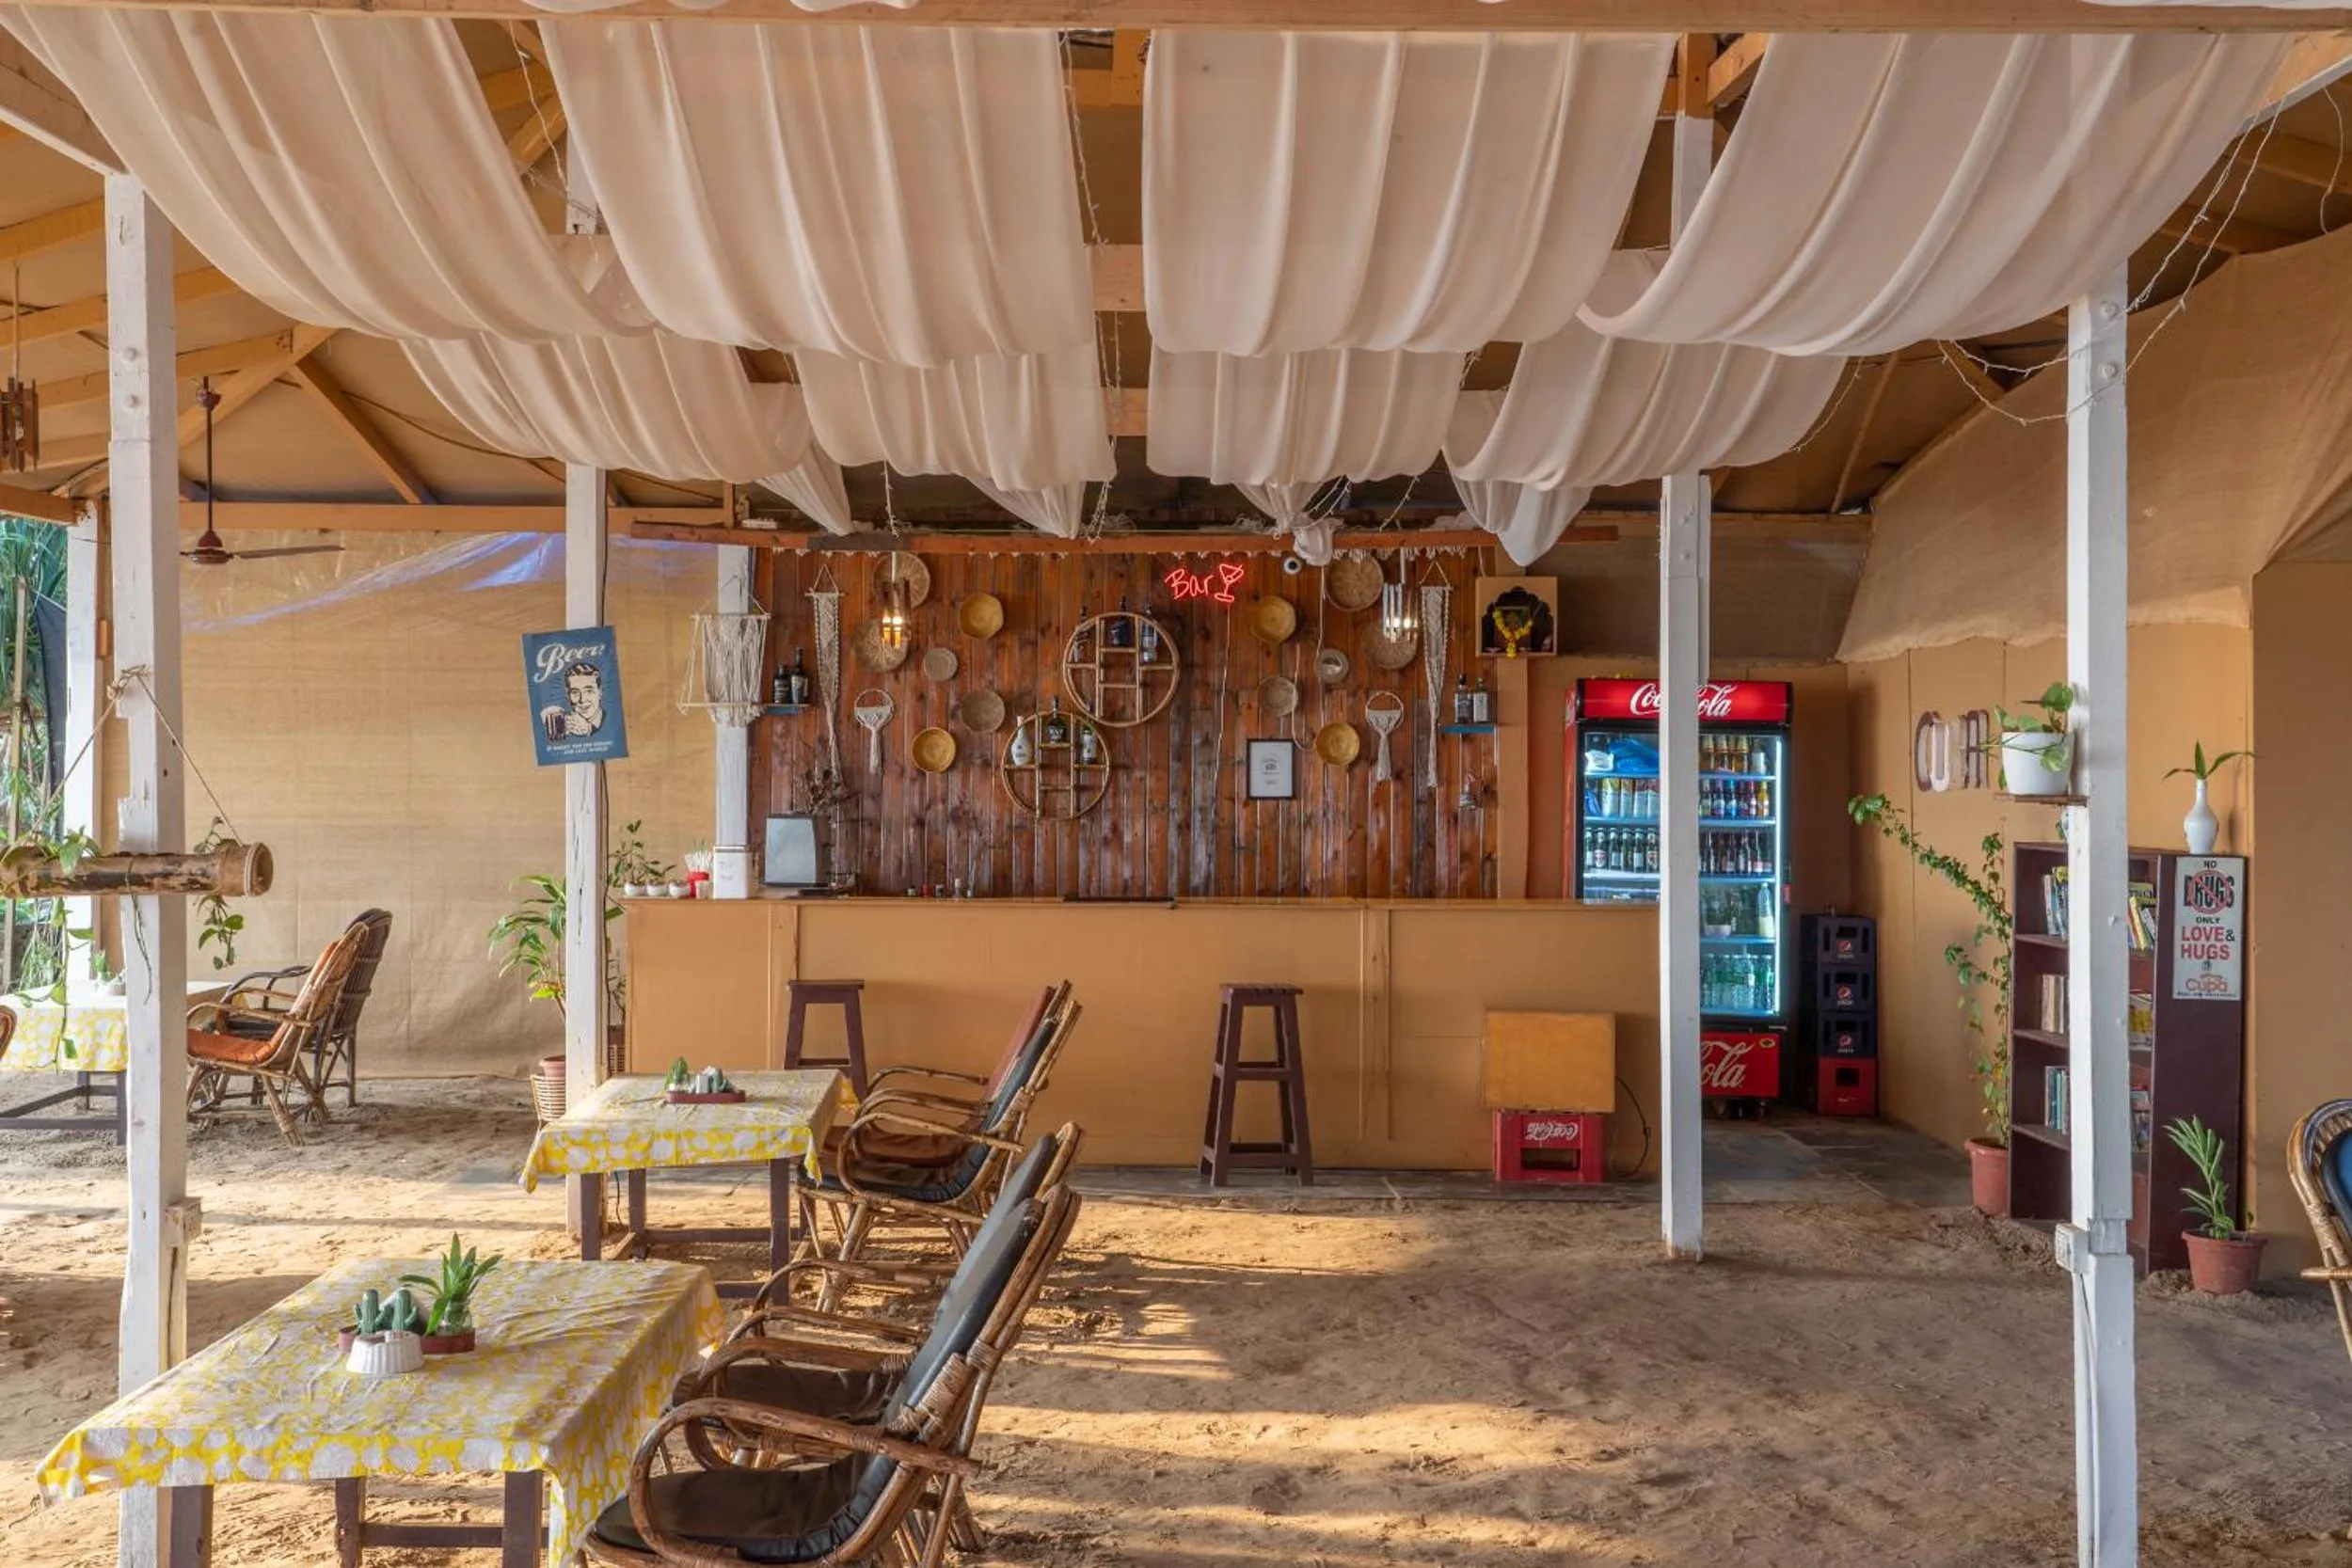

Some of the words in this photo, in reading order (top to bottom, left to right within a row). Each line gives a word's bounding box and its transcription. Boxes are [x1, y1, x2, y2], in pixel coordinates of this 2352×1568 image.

[1165, 569, 1214, 599] Bar
[2203, 860, 2217, 869] NO
[2184, 875, 2234, 908] DRUGS
[2182, 926, 2224, 942] LOVE
[2225, 928, 2235, 942] &
[2181, 943, 2230, 960] HUGS
